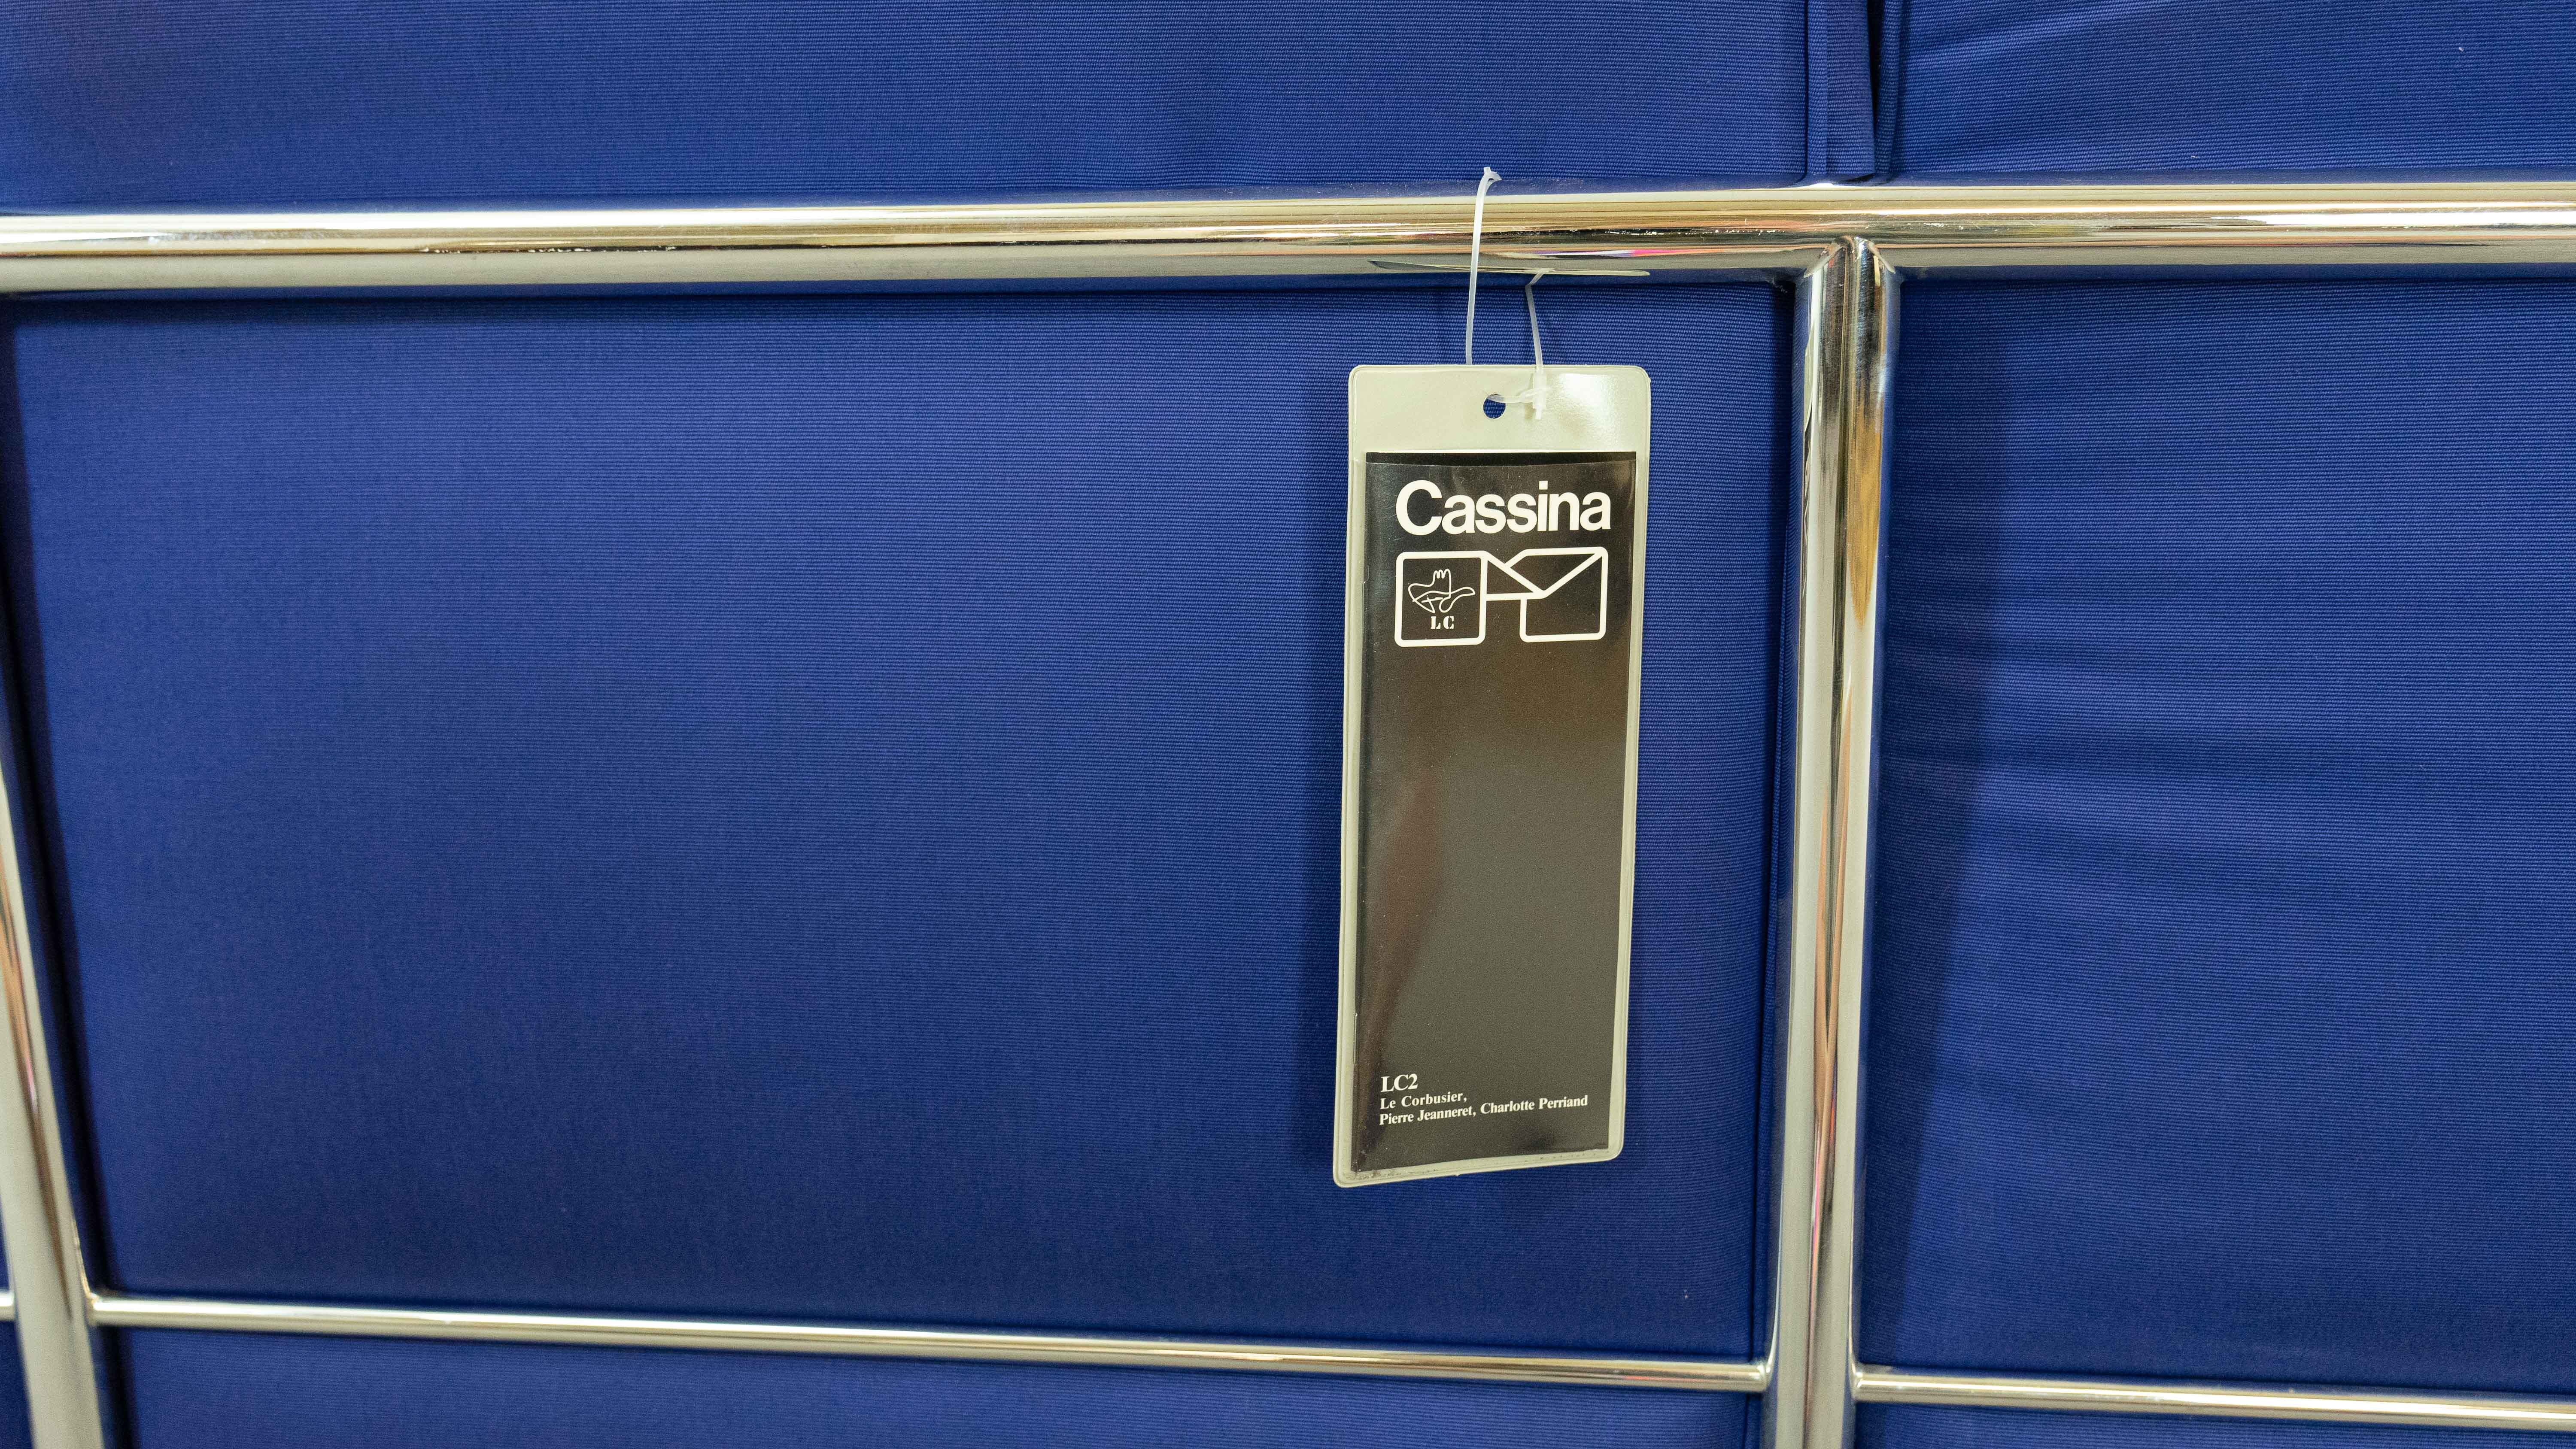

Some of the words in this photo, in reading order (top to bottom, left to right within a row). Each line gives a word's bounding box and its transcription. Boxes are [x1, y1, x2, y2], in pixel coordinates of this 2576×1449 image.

[1396, 479, 1611, 536] Cassina
[1431, 615, 1454, 630] LC
[1380, 1073, 1418, 1092] LC2
[1379, 1097, 1396, 1109] Le
[1401, 1091, 1467, 1107] Corbusier,
[1379, 1113, 1414, 1125] Pierre
[1417, 1105, 1476, 1122] Jeanneret,
[1480, 1100, 1535, 1115] Charlotte
[1538, 1094, 1589, 1110] Perriand
